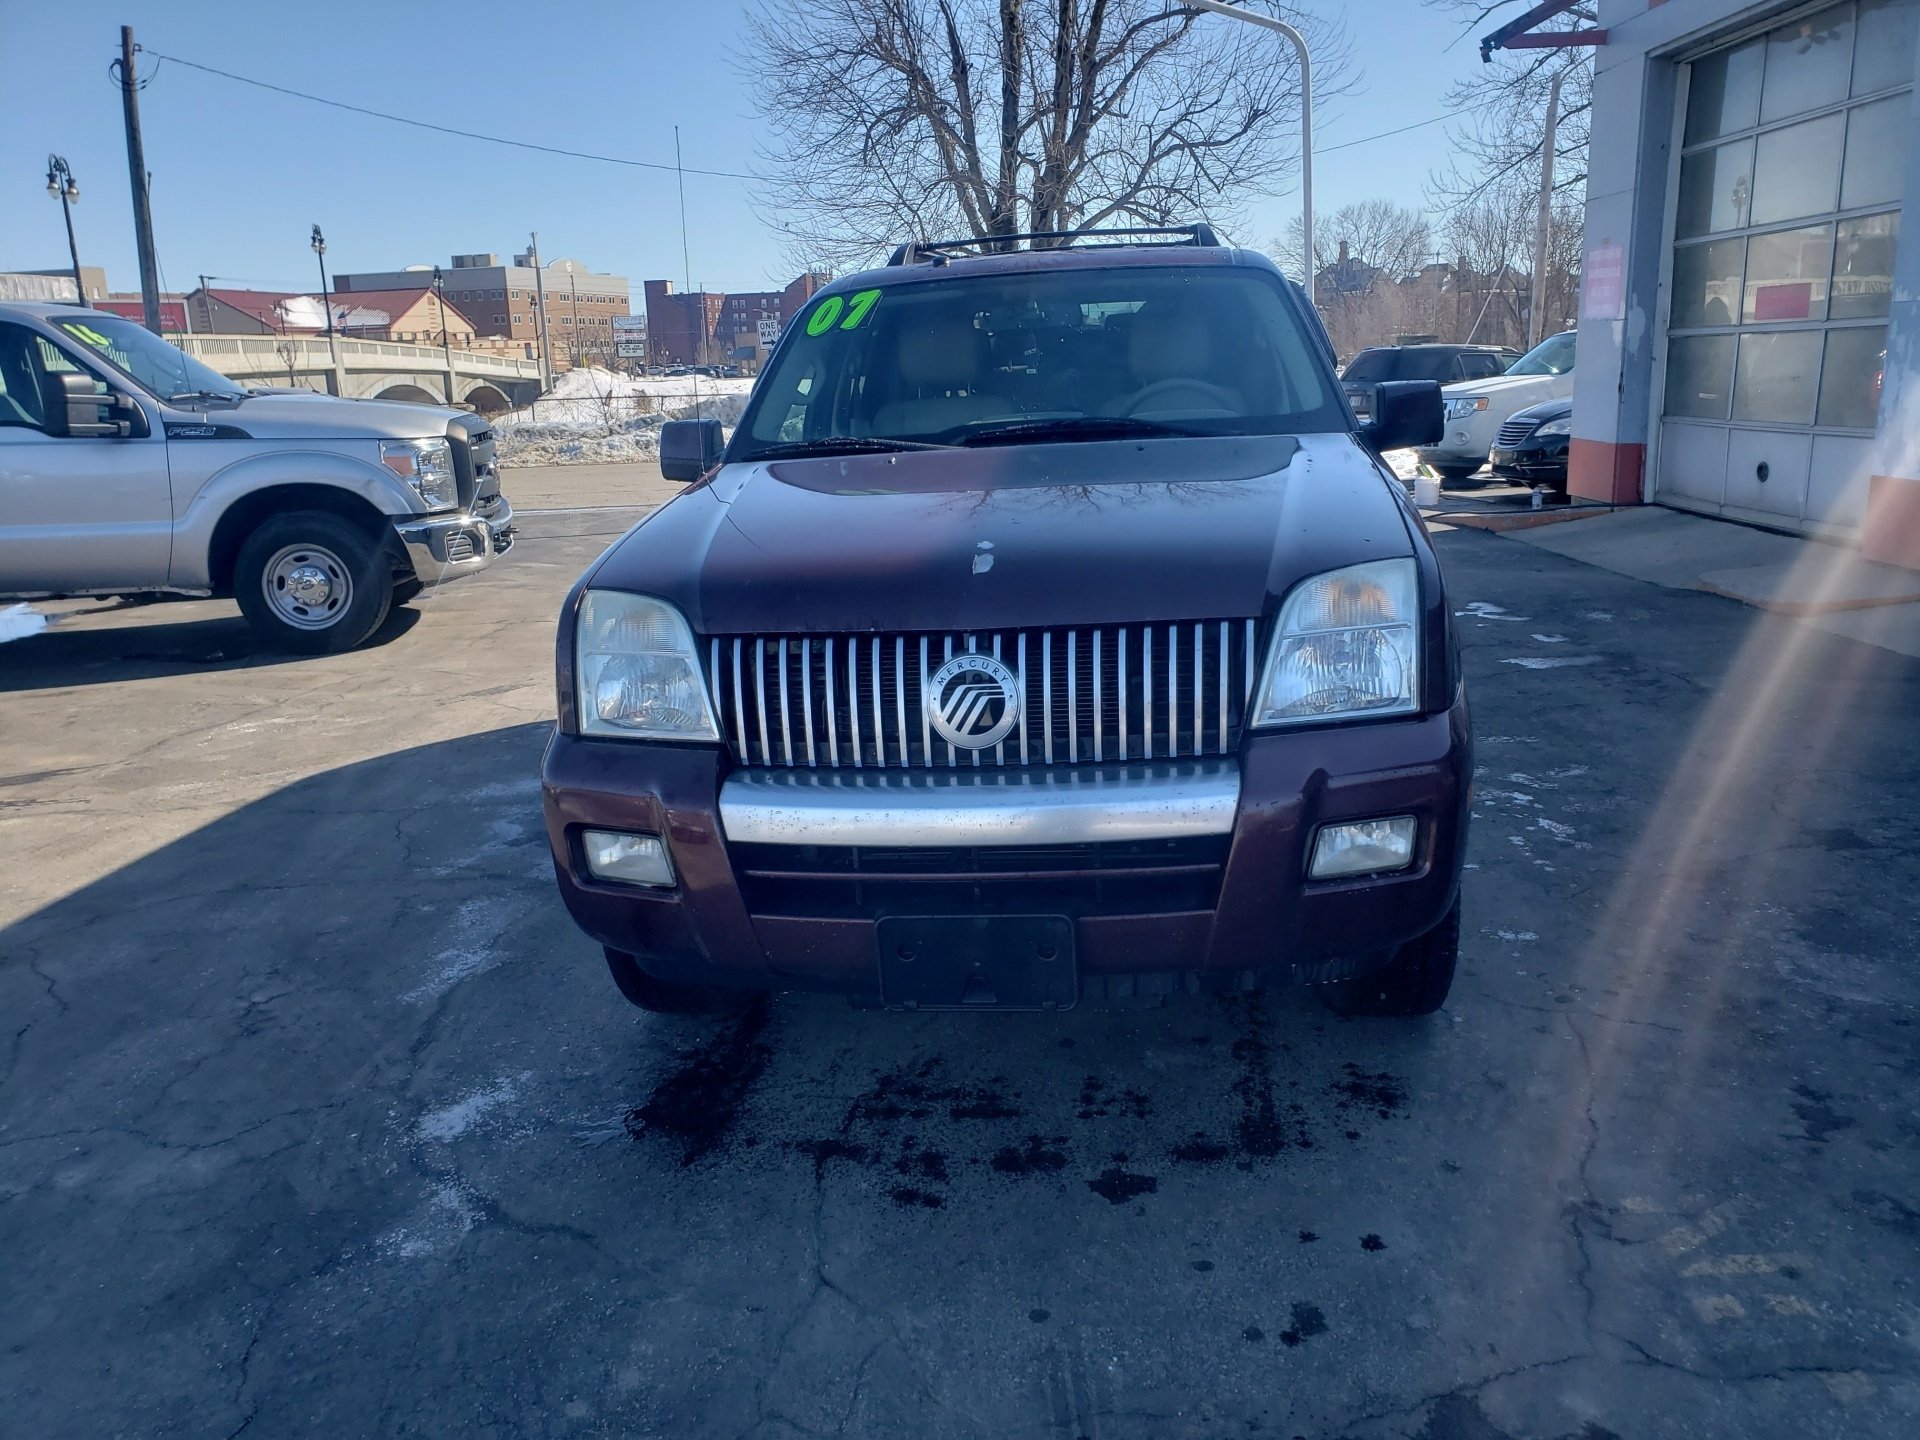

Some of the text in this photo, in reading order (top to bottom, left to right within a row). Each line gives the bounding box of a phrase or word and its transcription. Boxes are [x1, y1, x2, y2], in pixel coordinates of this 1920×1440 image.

[807, 289, 882, 336] 07
[760, 322, 776, 330] ONE
[760, 330, 776, 338] WAY
[937, 659, 1009, 686] MERCURY
